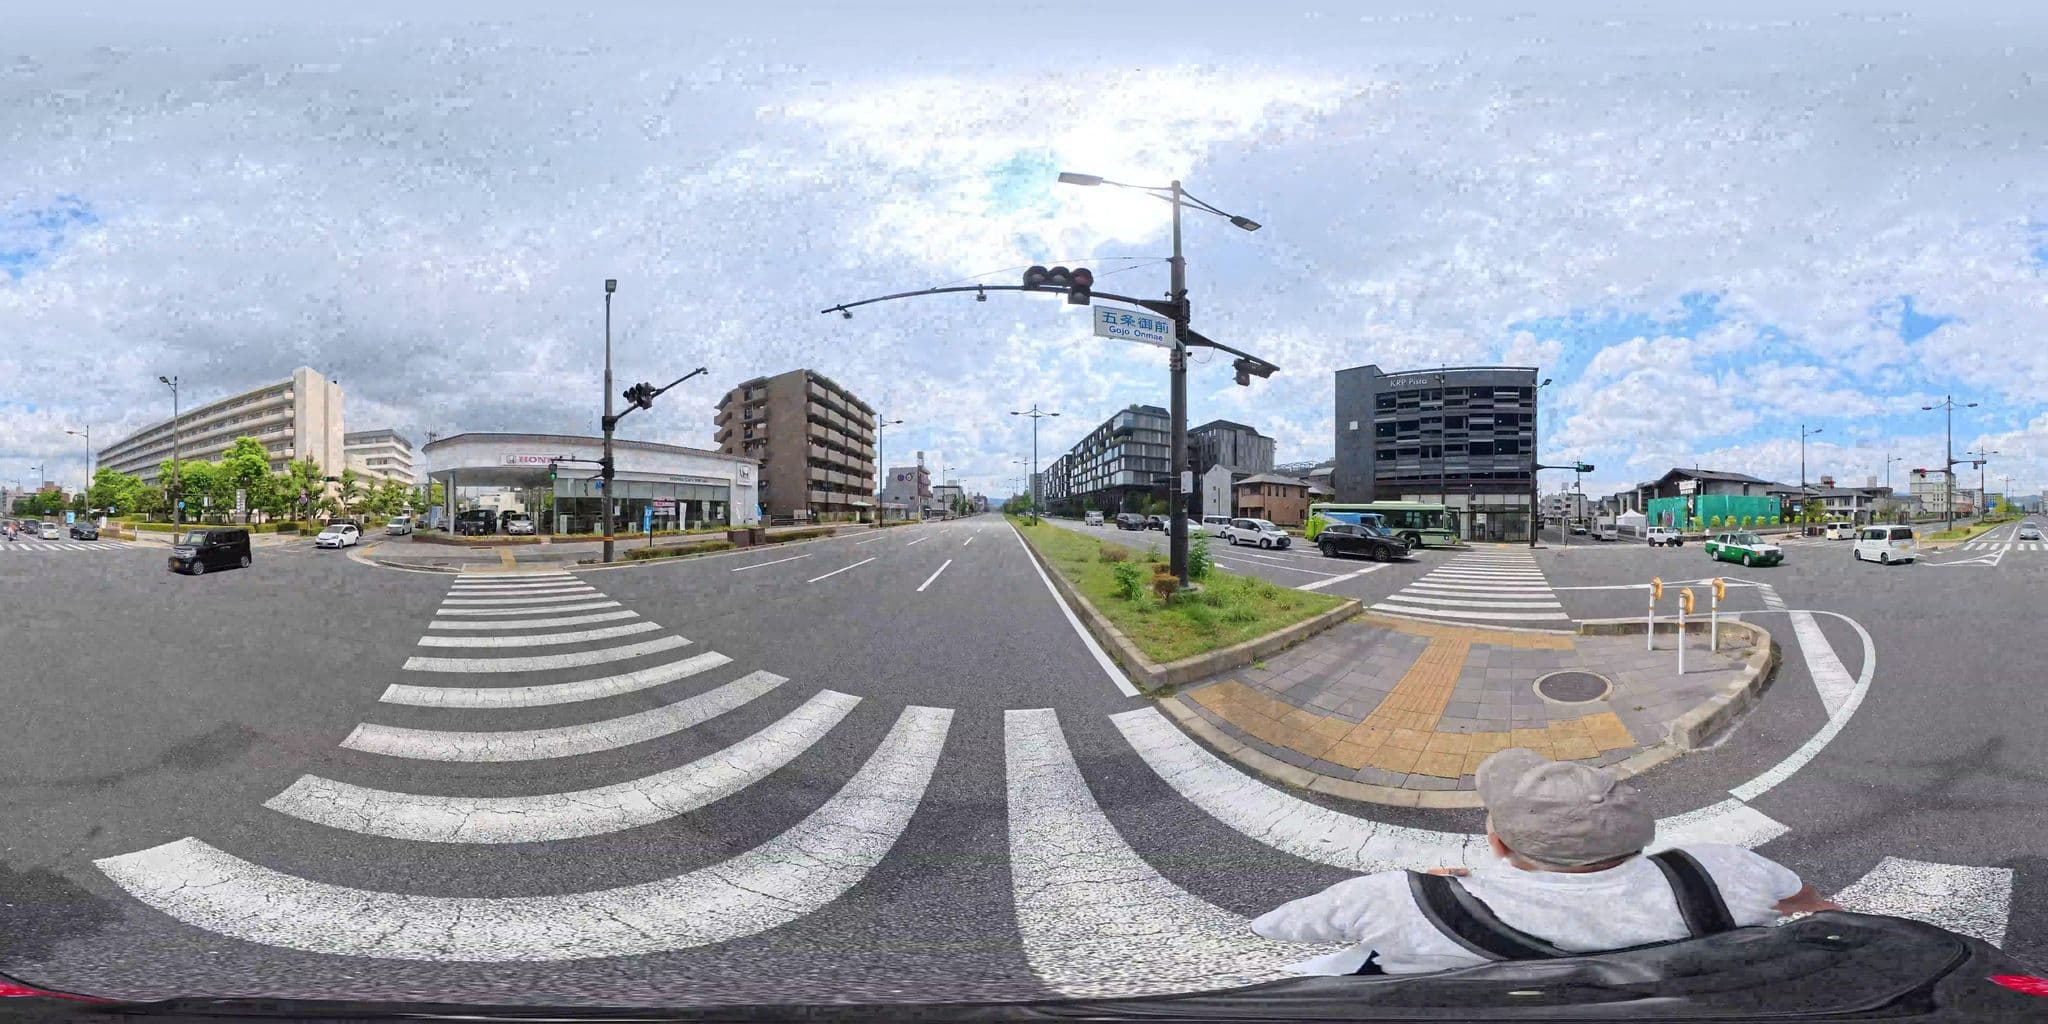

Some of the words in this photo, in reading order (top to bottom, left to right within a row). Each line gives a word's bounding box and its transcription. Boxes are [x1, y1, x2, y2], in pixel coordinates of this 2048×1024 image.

[1103, 311, 1169, 334] 五条御前
[1109, 325, 1130, 336] Gojo
[1134, 329, 1164, 342] Onmae
[1390, 379, 1407, 387] KRP
[519, 455, 561, 466] HON
